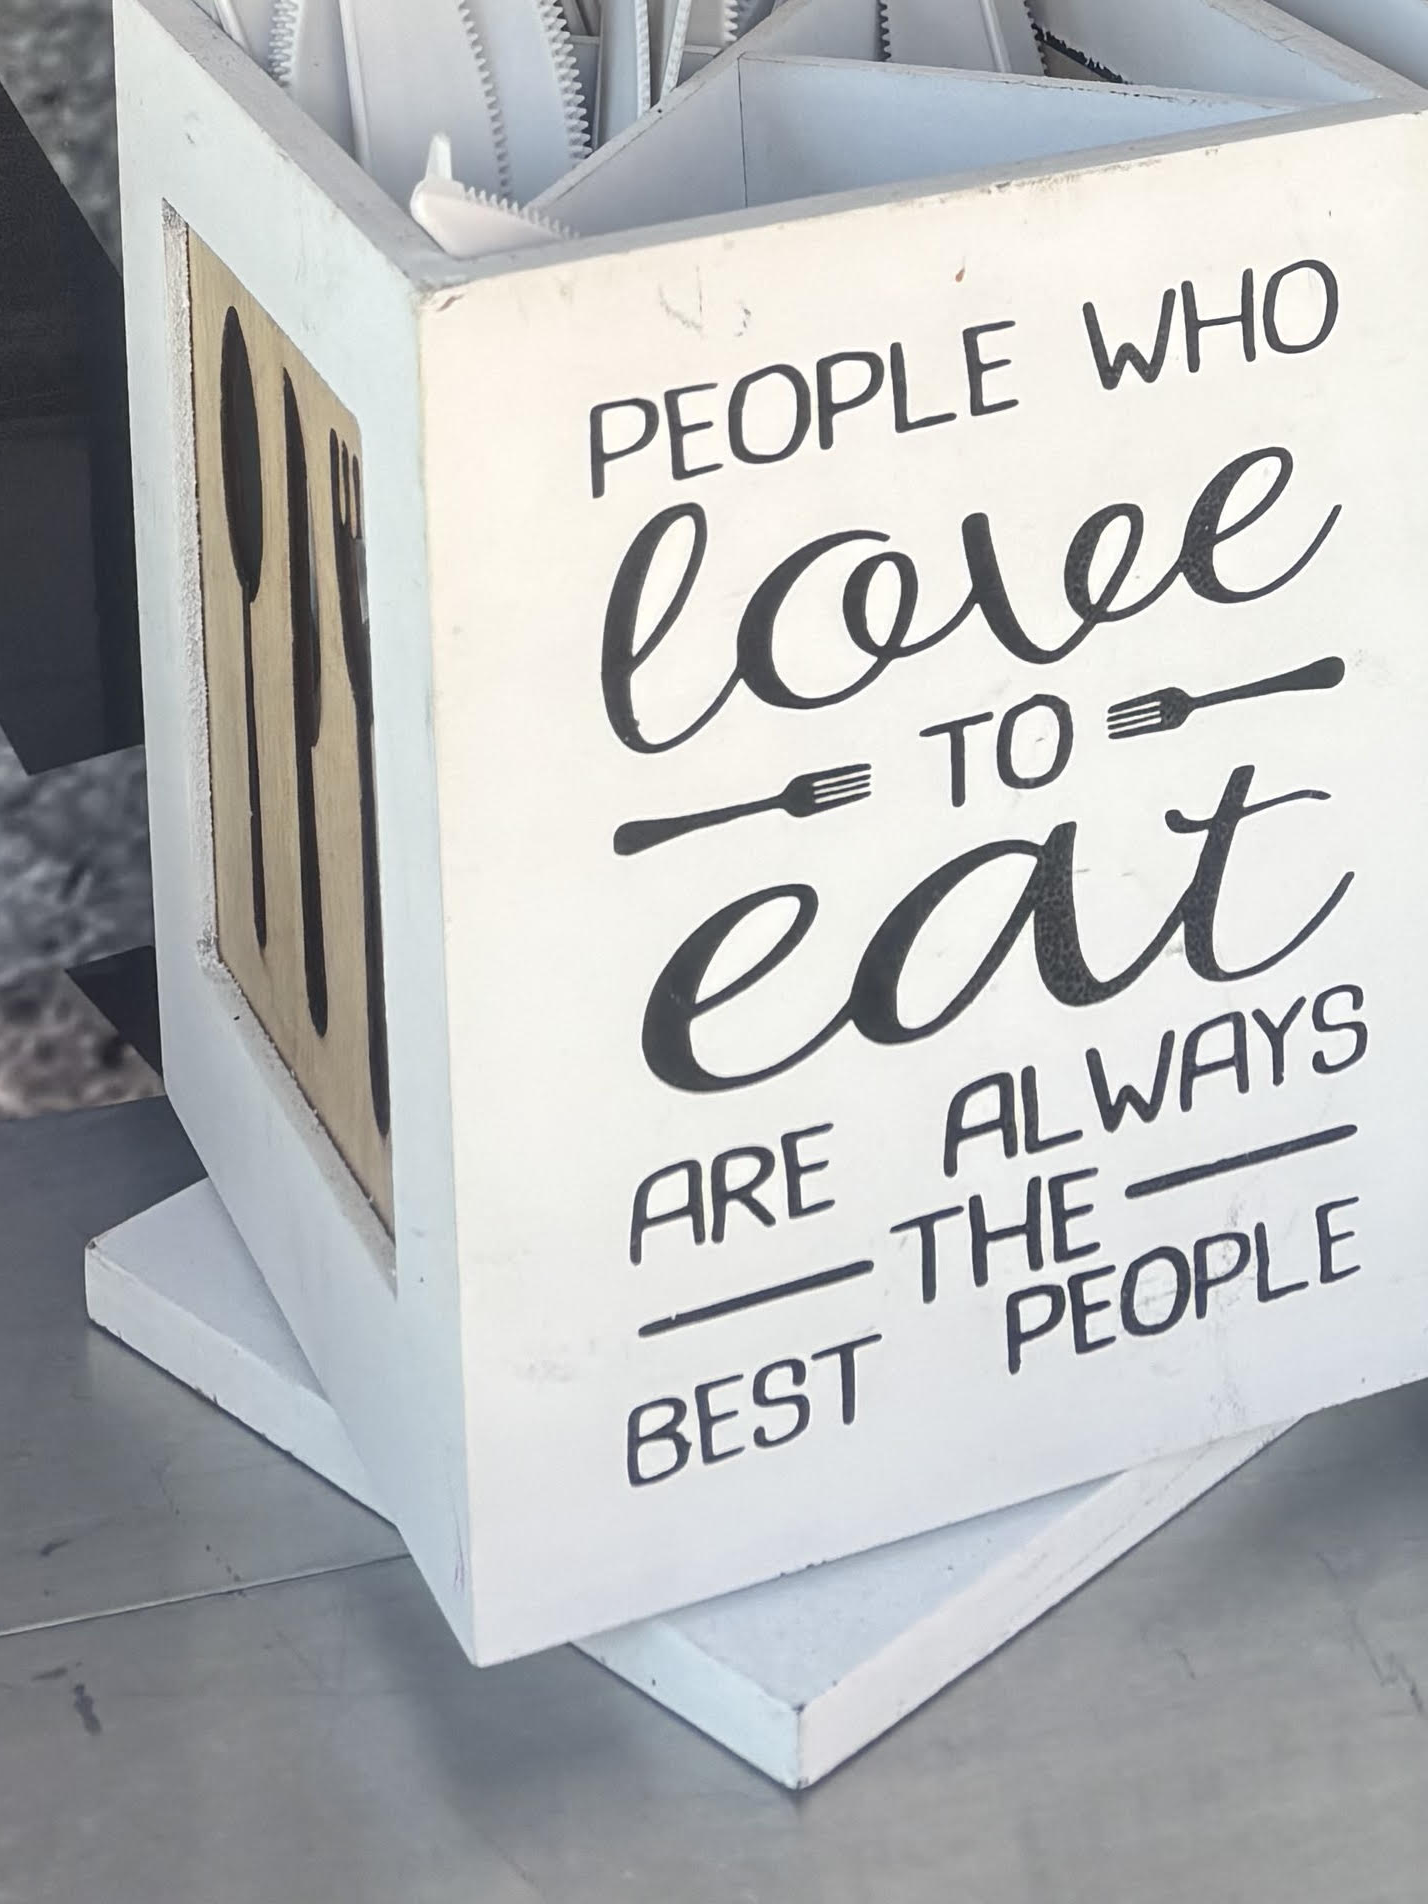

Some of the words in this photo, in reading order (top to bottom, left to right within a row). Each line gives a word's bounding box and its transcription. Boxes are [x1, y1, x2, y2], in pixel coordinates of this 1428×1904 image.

[589, 319, 1019, 499] PEOPLE
[1082, 258, 1339, 391] WHO
[600, 446, 1342, 754] love
[918, 693, 1074, 808] TO
[641, 764, 1355, 1094] eat
[628, 1122, 835, 1266] ARE
[942, 984, 1368, 1177] ALWAYS
[889, 1166, 1100, 1304] THE
[626, 1332, 882, 1488] BEST
[1006, 1196, 1360, 1374] PEOPLE
